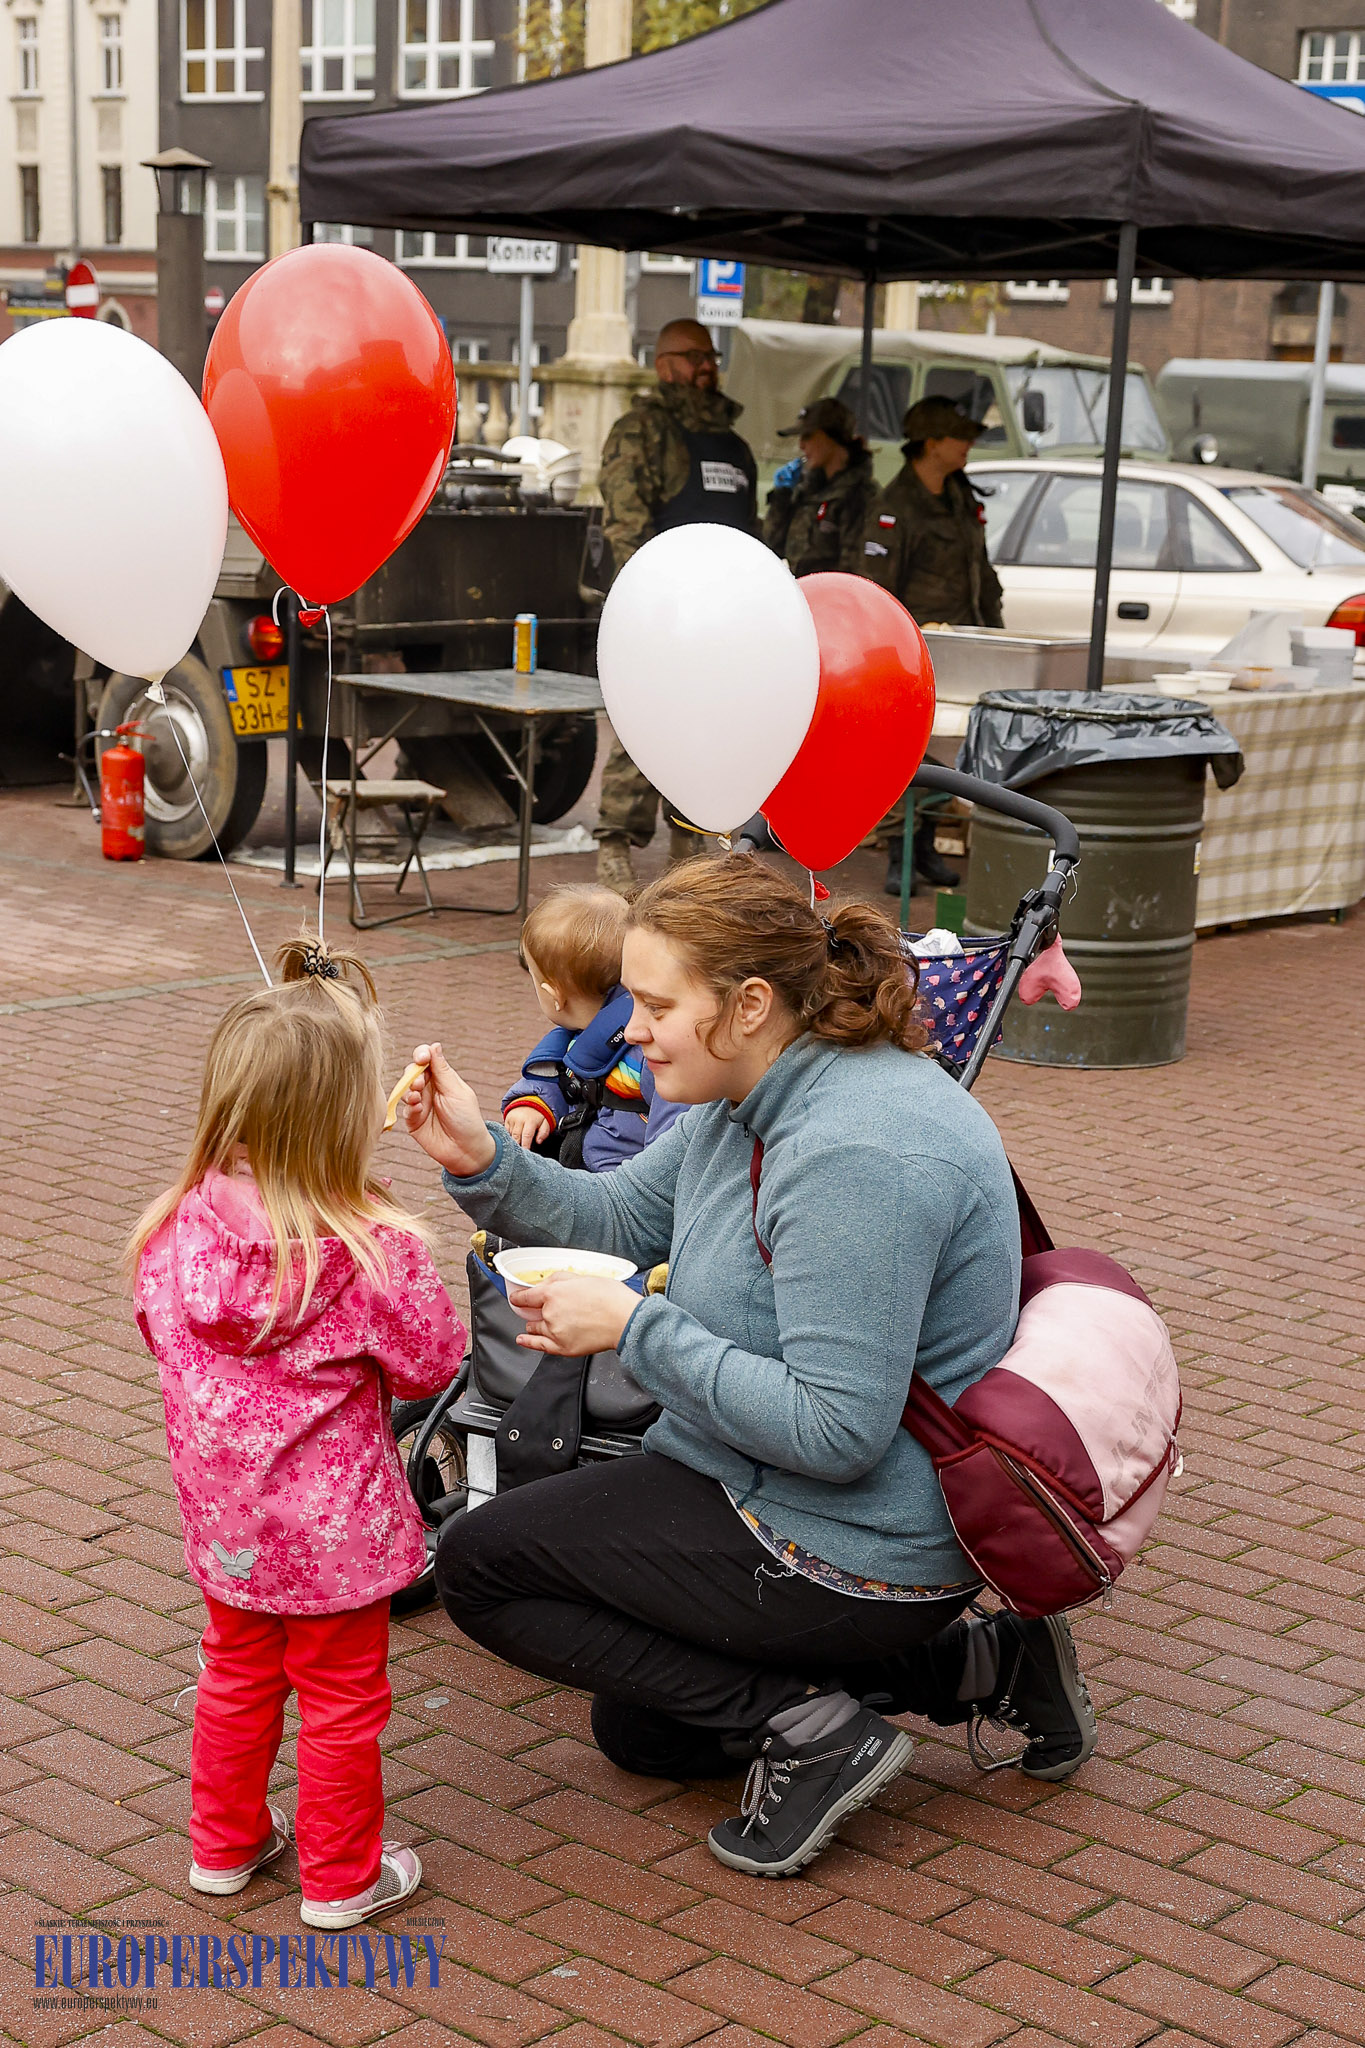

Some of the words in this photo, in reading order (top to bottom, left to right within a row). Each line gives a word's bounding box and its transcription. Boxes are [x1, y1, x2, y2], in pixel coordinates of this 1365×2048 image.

[708, 258, 737, 292] P
[245, 669, 276, 698] SZ
[234, 700, 275, 731] 33H
[851, 1736, 876, 1766] QUECHUA
